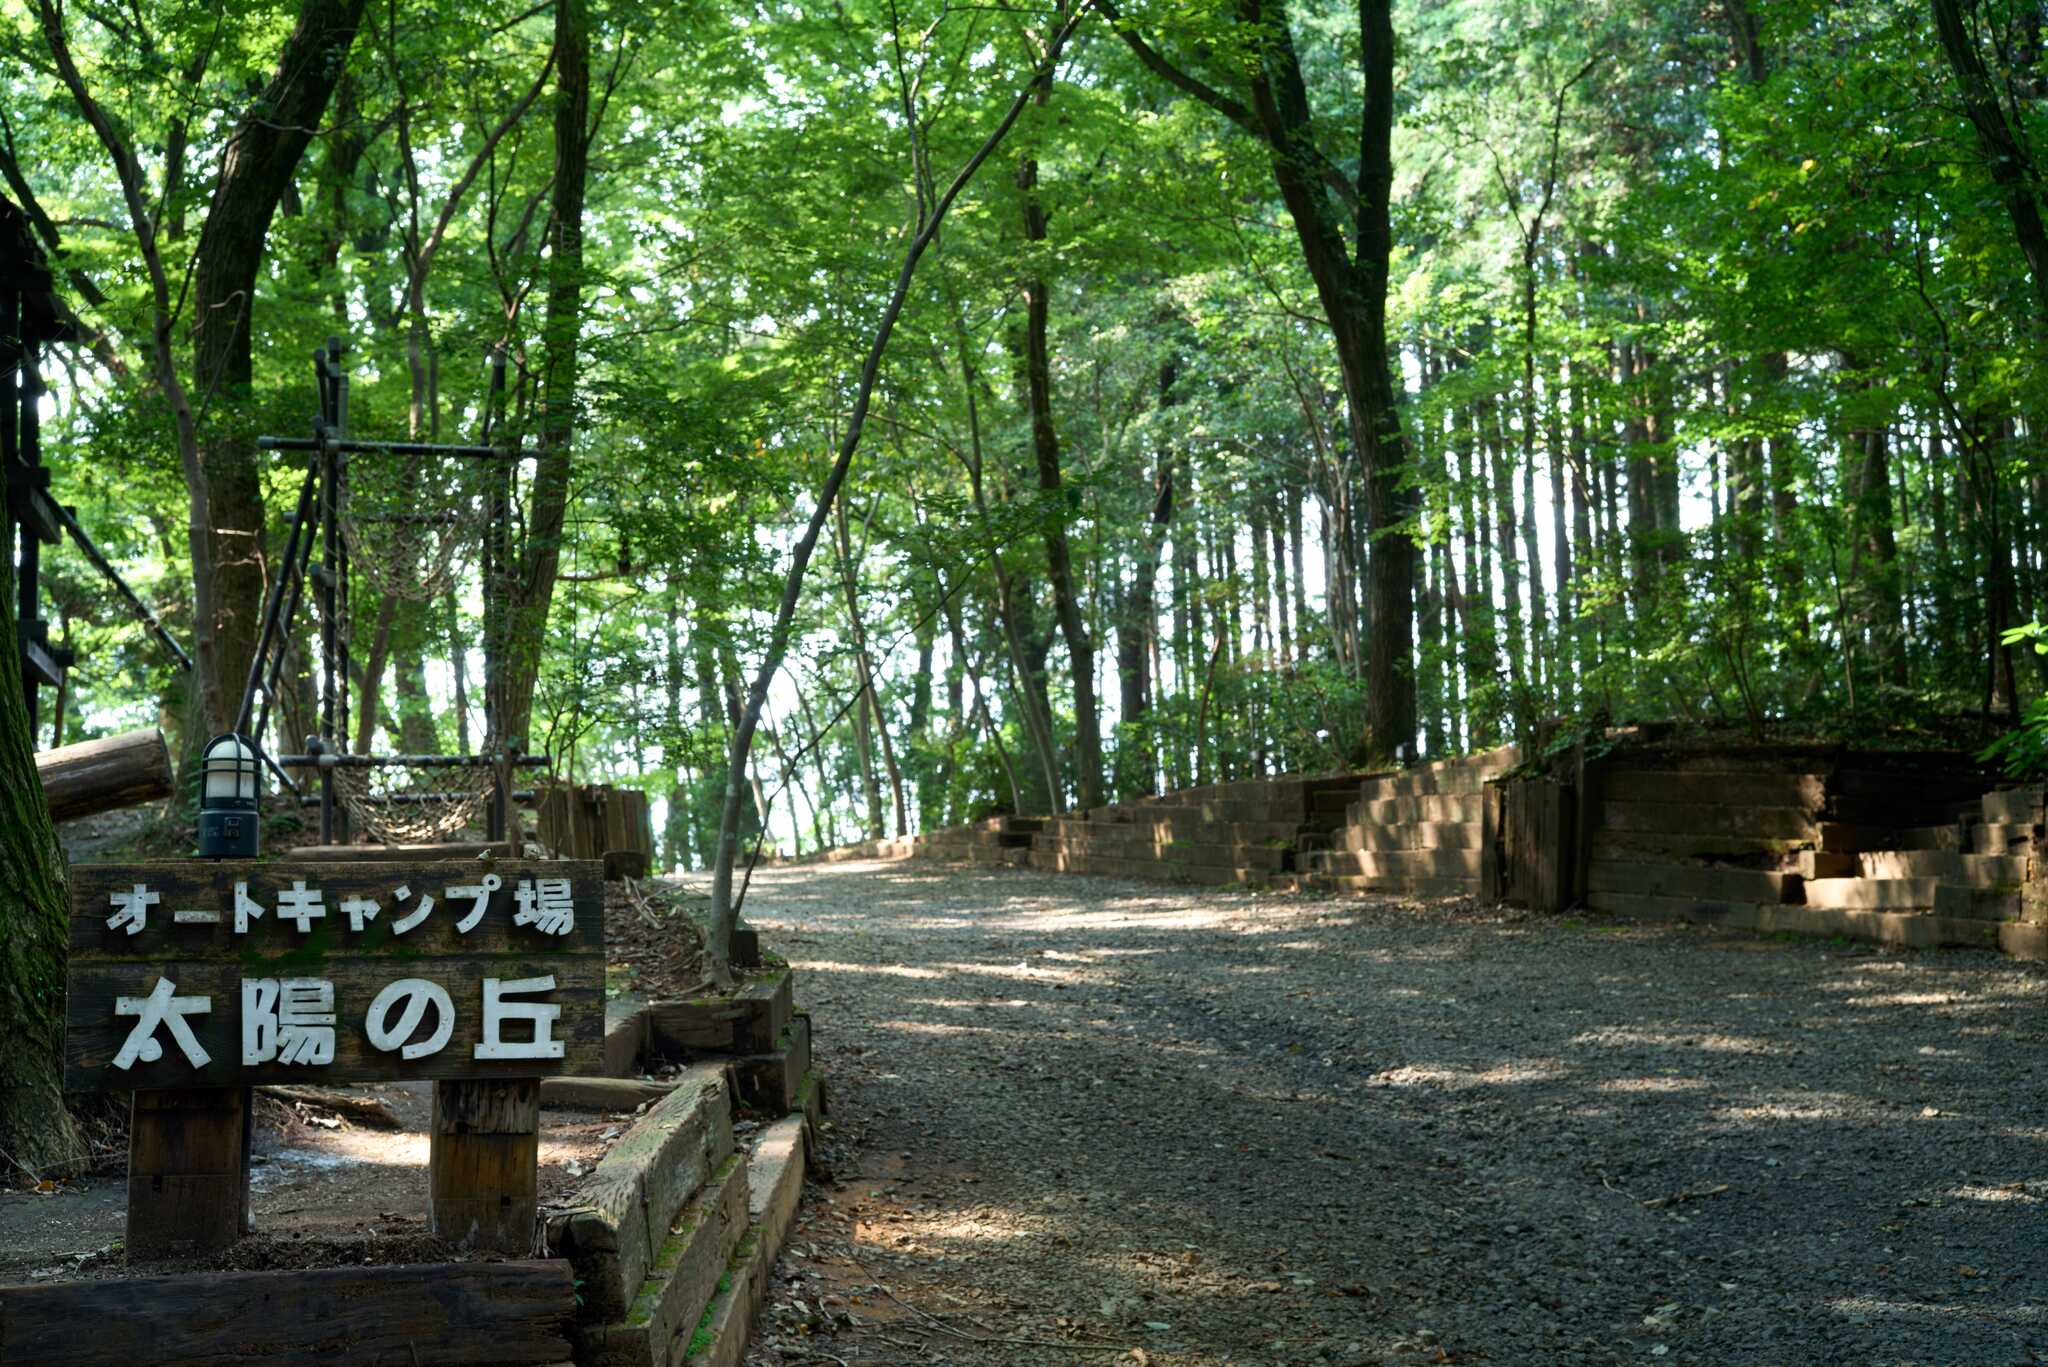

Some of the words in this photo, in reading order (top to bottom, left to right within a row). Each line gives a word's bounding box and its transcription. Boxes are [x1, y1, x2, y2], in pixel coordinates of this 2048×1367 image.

[106, 873, 574, 935] オートキャンプ場
[112, 975, 565, 1070] 太陽の丘
